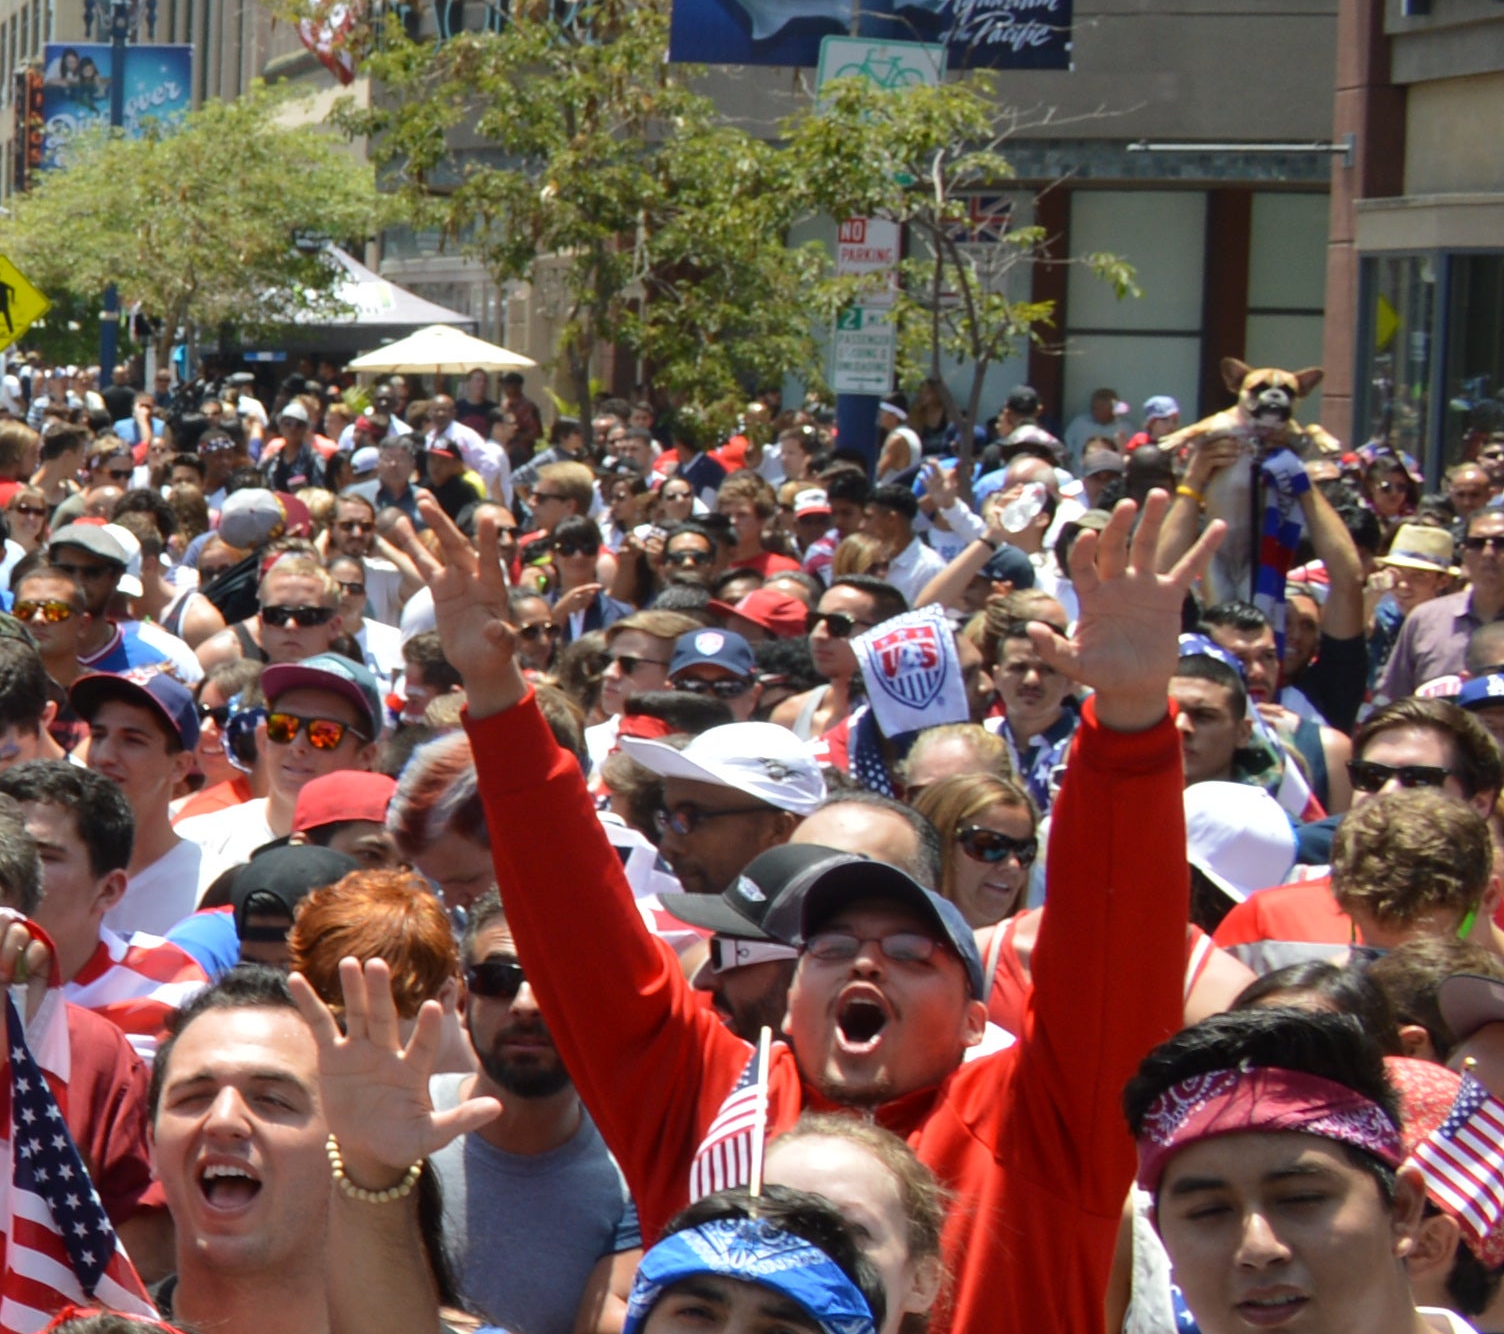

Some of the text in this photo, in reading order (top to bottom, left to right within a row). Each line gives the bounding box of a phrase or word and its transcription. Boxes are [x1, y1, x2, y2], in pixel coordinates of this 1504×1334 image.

[972, 10, 1054, 52] Pacific
[839, 220, 864, 243] NO
[841, 247, 893, 264] PARKING
[842, 309, 856, 328] 2
[880, 640, 939, 680] US
